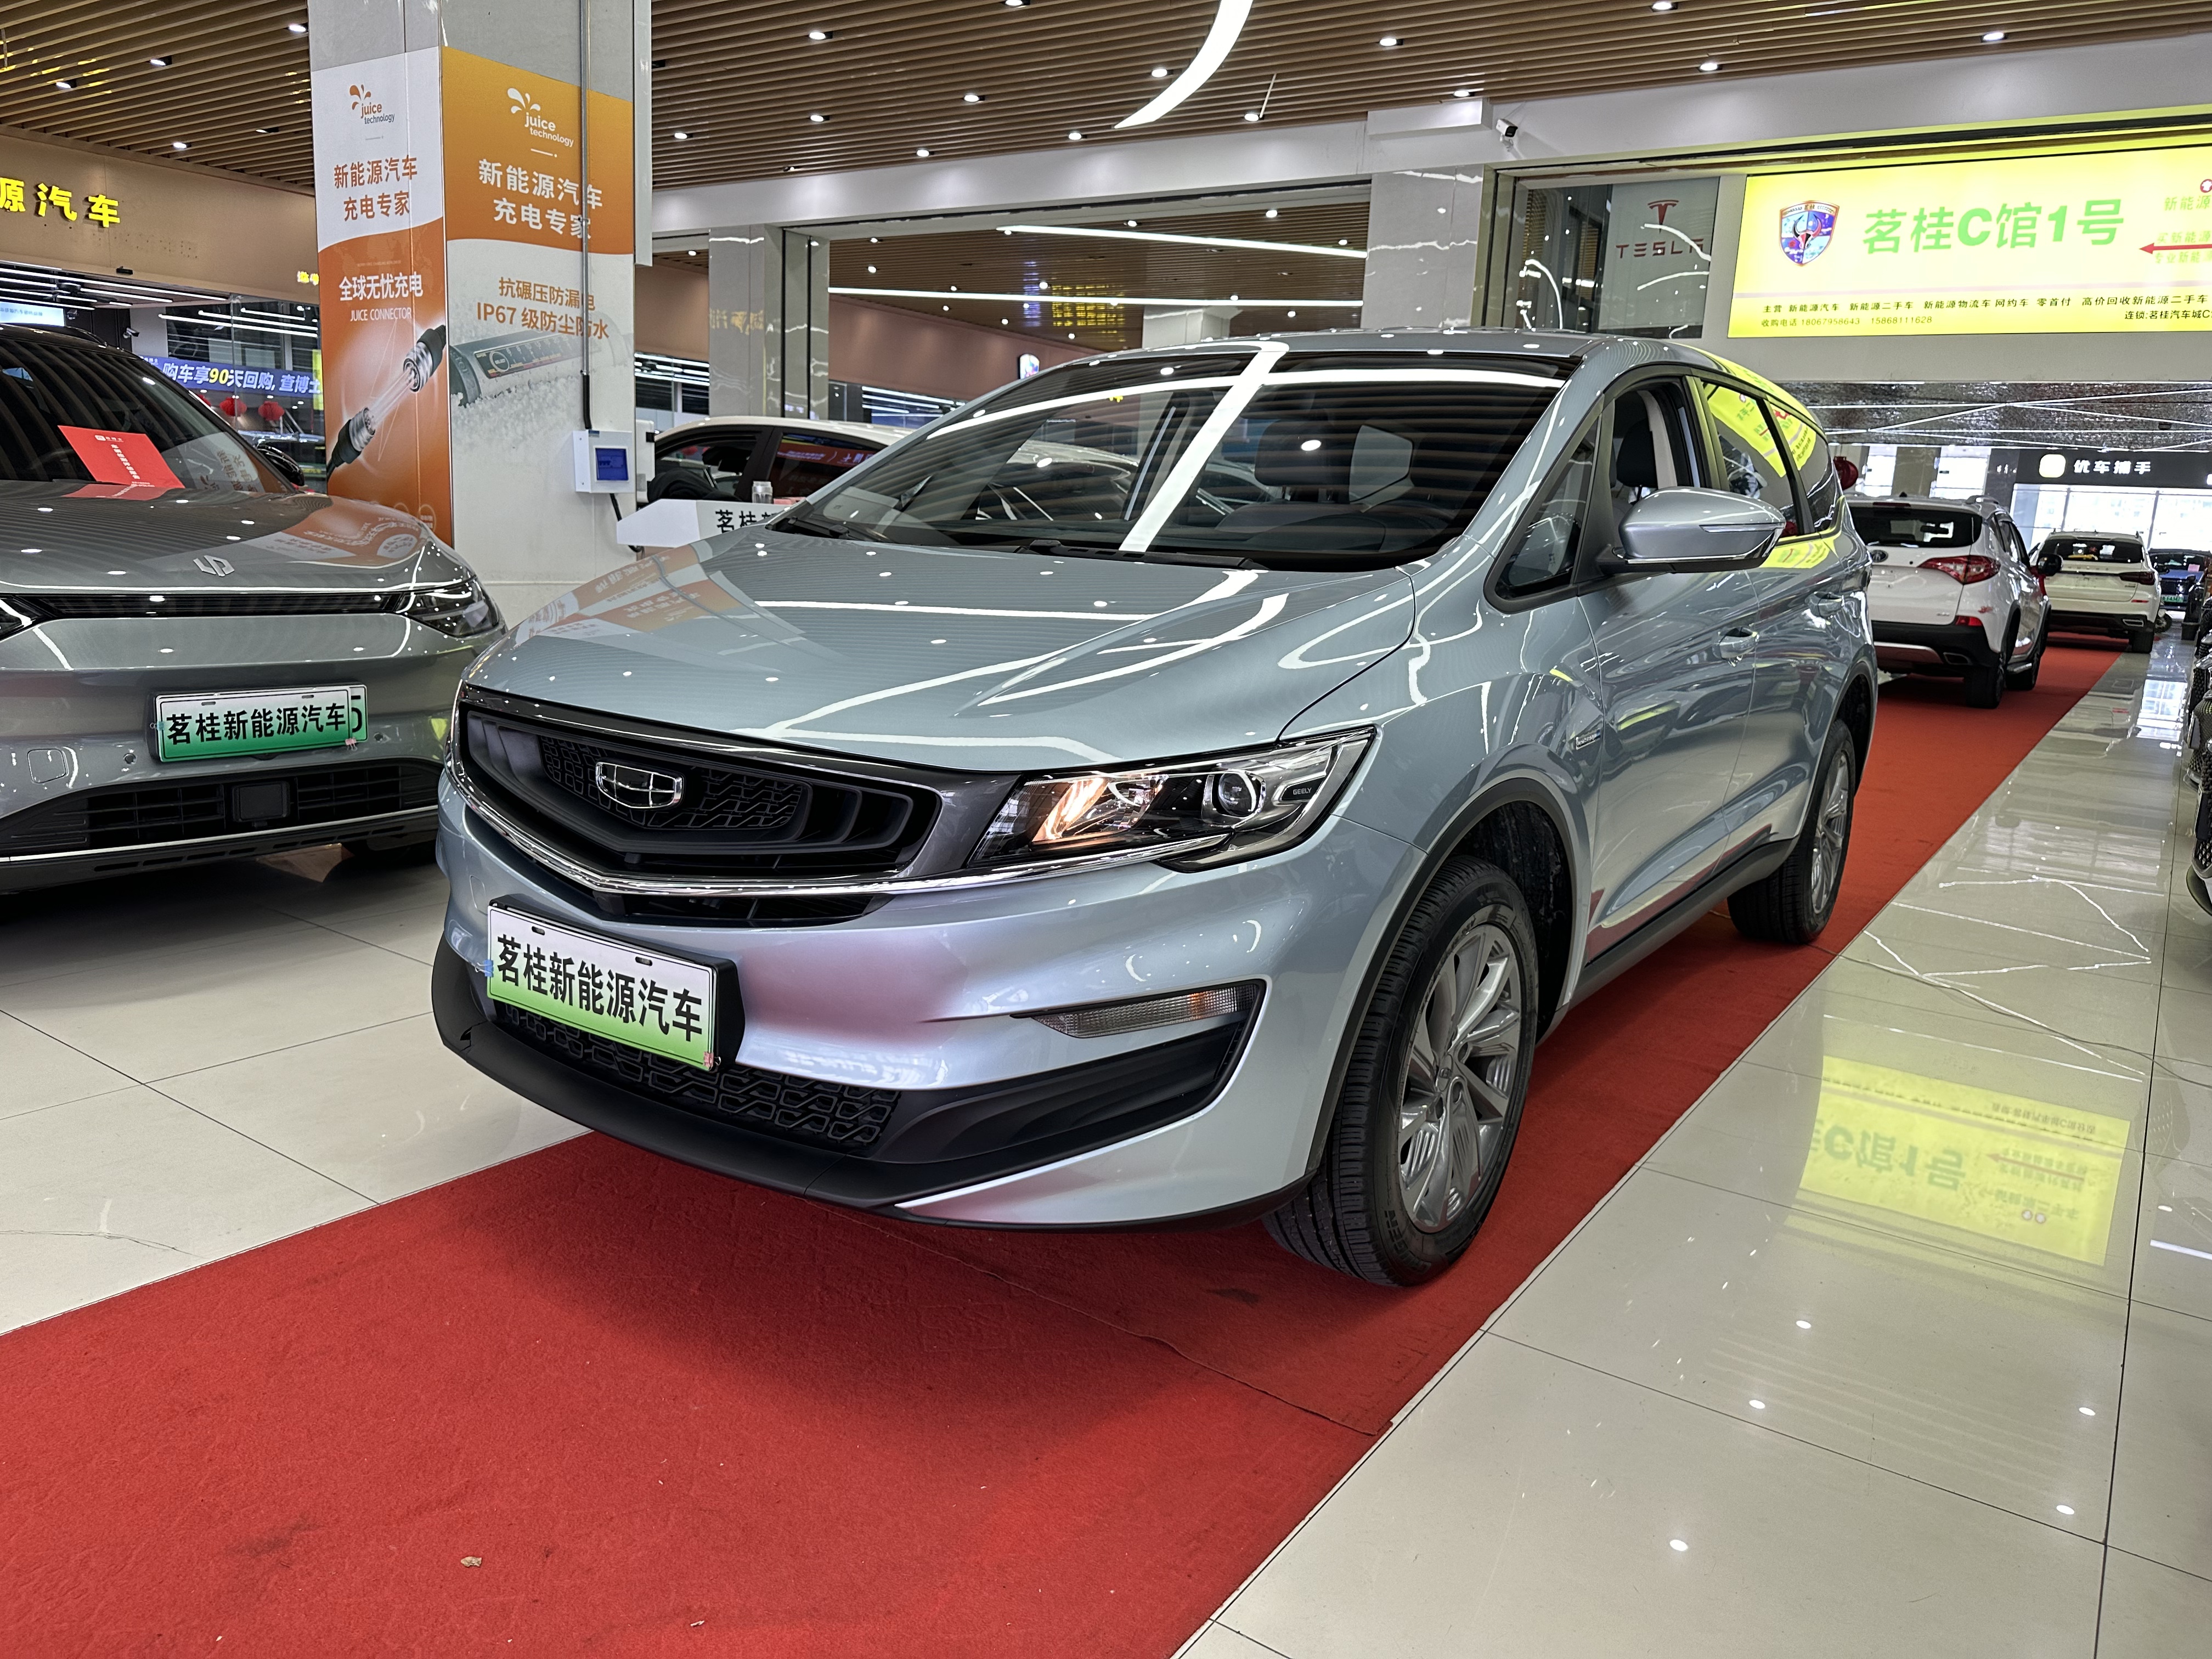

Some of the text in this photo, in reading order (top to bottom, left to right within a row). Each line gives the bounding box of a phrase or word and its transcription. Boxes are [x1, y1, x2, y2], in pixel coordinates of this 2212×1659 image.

[360, 102, 382, 119] juice
[364, 113, 395, 125] technology
[524, 112, 556, 131] juice
[530, 127, 574, 148] technology
[334, 154, 417, 189] 新能源汽车
[478, 158, 602, 210] 新能源汽车
[0, 177, 121, 228] 源汽车
[343, 190, 410, 222] 充电专家
[493, 198, 591, 240] 充电专家
[1863, 199, 2124, 255] 茗桂C馆1号
[1616, 238, 1704, 258] TESLA
[339, 271, 424, 301] 全球无忧充电
[350, 307, 412, 321] JUICE CONNECTOR
[1763, 294, 2208, 313] 主营 新能源汽车 新能源二手车 新能源物流车 网约车 零首付 高价回收新能源二手车
[477, 302, 610, 340] IP67 级防尘防水
[1761, 318, 1798, 327] 收购电话
[1871, 316, 1933, 325] 15868111628
[715, 509, 777, 533] 茗桂
[167, 703, 346, 745] 茗桂新能源汽车
[498, 934, 702, 1042] 茗桂新能源汽车
